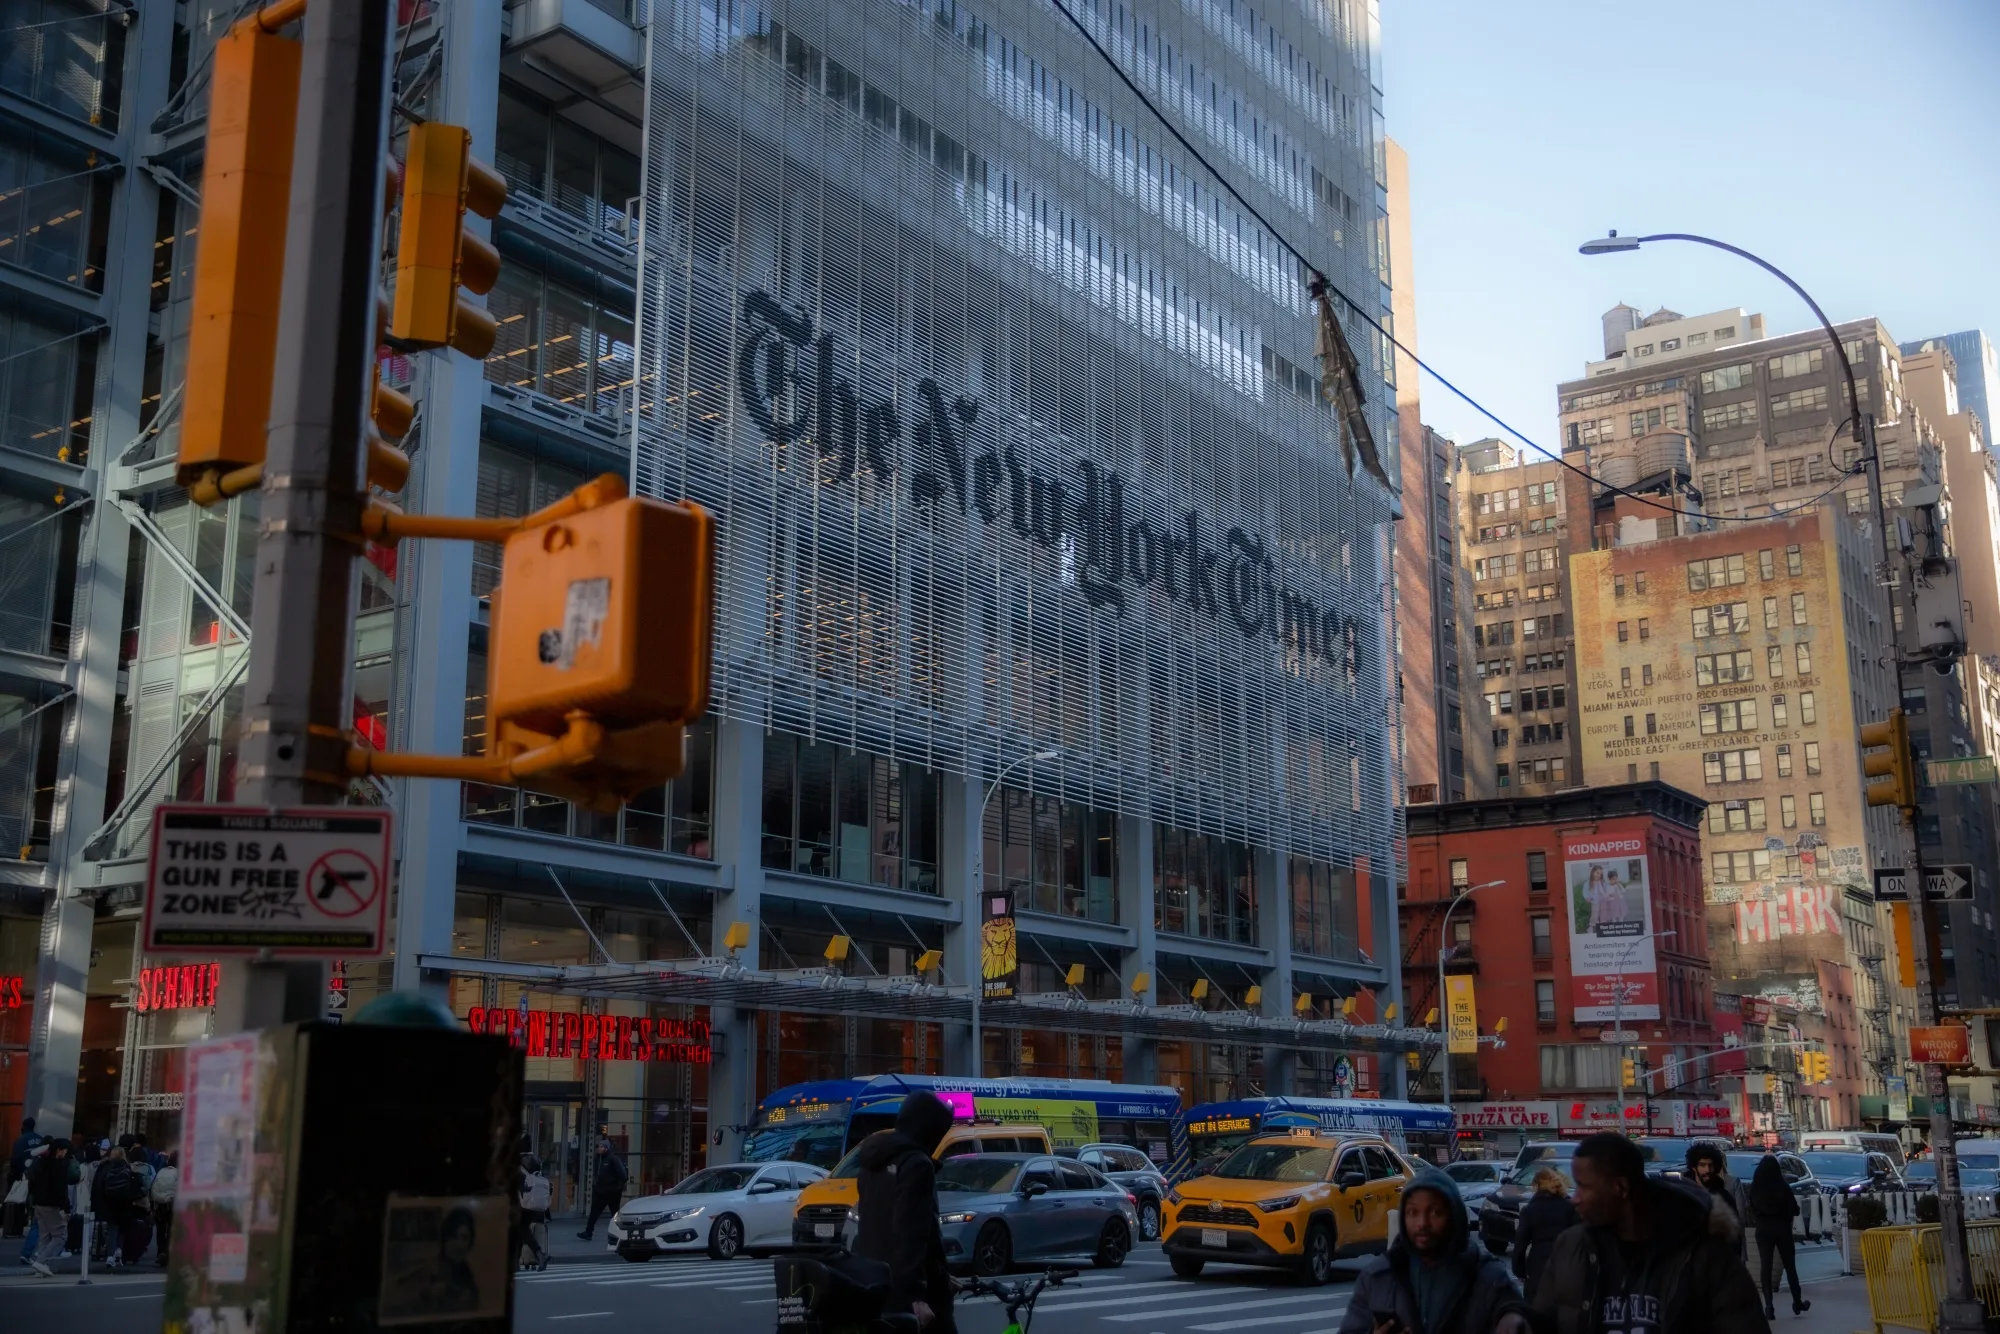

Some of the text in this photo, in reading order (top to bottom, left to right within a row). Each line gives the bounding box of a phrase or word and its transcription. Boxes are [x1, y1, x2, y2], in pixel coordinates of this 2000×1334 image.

[737, 289, 1364, 680] The New York Times
[1592, 671, 1608, 680] LAS
[1657, 669, 1693, 682] ANGELES
[1586, 679, 1614, 691] VEGAS
[1583, 702, 1613, 714] MIAMI
[1657, 692, 1693, 705] PUERTO
[1696, 689, 1719, 701] RICO
[1722, 683, 1768, 698] BERMUDA
[1773, 677, 1821, 692] BAHAMAS
[1606, 688, 1647, 701] MEXICO
[1662, 710, 1693, 722] SOUTH
[1587, 723, 1619, 736] EUROPE
[1659, 720, 1697, 733] AMERICA
[1604, 733, 1679, 750] MEDITERRANEAN
[1605, 747, 1641, 759] MIDDLE
[1646, 744, 1670, 755] EAST
[1713, 735, 1750, 748] ISLAND
[1936, 760, 1991, 783] W 41 St
[222, 816, 328, 831] TIMES SQUARE
[166, 840, 288, 863] THIS IS A
[1568, 839, 1642, 855] KIDNAPPED
[162, 866, 301, 889] GUN FREE
[1888, 877, 1957, 891] ON WAY
[161, 894, 238, 915] ZONE
[1735, 885, 1843, 945] MERK
[1584, 942, 1625, 950] Antisemites
[1588, 951, 1614, 959] tearing
[1584, 959, 1643, 968] hostage posters
[0, 976, 23, 1009] 'S
[1454, 1003, 1469, 1011] THE
[1452, 1013, 1472, 1026] LION
[657, 1018, 712, 1041] QUALITY
[1451, 1027, 1475, 1041] KING
[1920, 1040, 1958, 1050] WRONG
[656, 1043, 712, 1064] KITCHEN
[1928, 1050, 1951, 1060] WAY
[1011, 1082, 1031, 1095] bus
[978, 1108, 1040, 1121] MULLVAD VPN
[1462, 1112, 1550, 1126] PIZZA CAFE
[1189, 1118, 1251, 1134] NOT IN SERVICE
